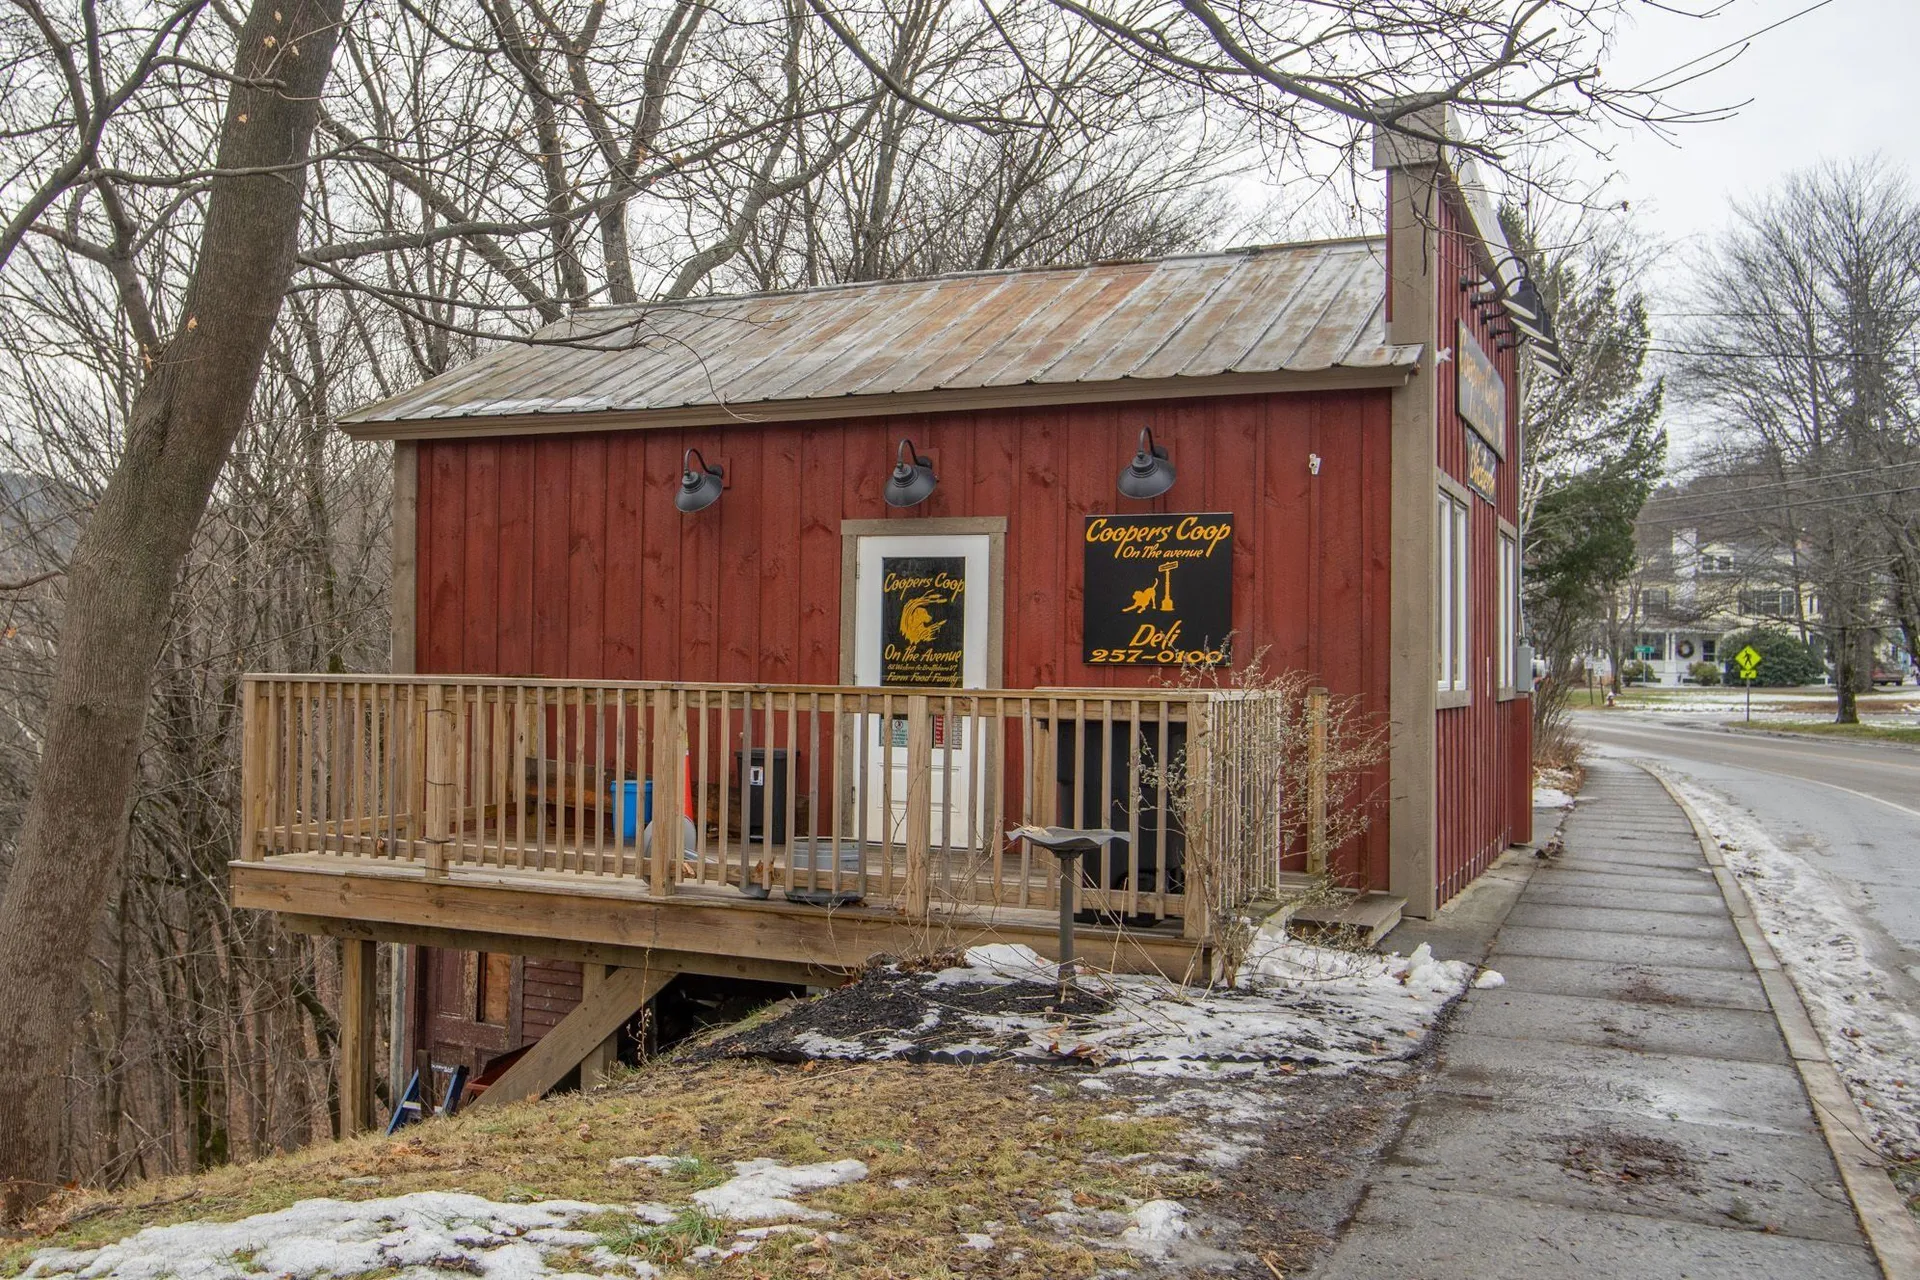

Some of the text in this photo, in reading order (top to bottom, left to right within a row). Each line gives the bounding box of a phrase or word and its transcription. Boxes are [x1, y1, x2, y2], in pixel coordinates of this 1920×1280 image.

[1085, 516, 1232, 559] Coopers Coop
[1122, 545, 1140, 559] On
[1163, 549, 1204, 559] avenue
[884, 572, 965, 603] Coopers Coop
[1128, 619, 1183, 650] Deli
[884, 643, 901, 661] On
[920, 648, 962, 662] Avenue
[1089, 648, 1224, 664] 257-0100
[887, 671, 909, 682] Farm
